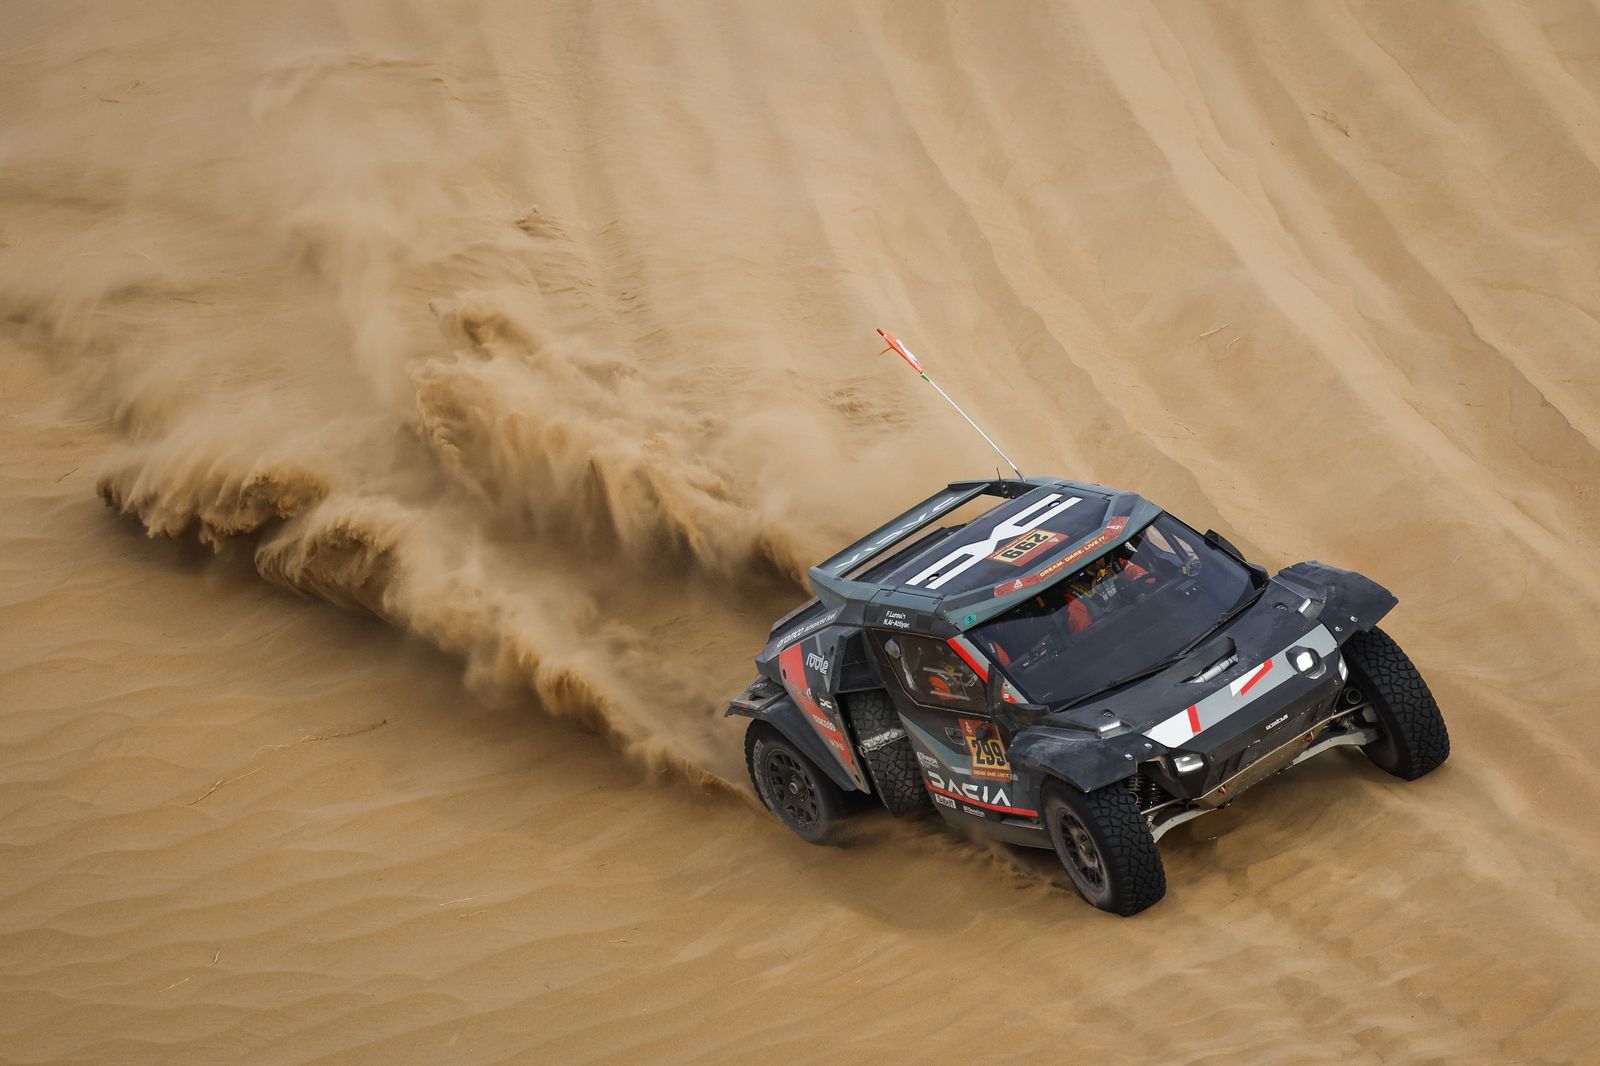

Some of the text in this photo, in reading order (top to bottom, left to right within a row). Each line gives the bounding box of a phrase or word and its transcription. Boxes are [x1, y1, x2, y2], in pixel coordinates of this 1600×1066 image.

[1000, 533, 1049, 559] 299
[1039, 560, 1065, 578] DREAM.
[1065, 548, 1085, 562] DARE.
[1085, 540, 1100, 554] LIVE
[971, 738, 1006, 767] 299
[927, 770, 1012, 807] DACIA
